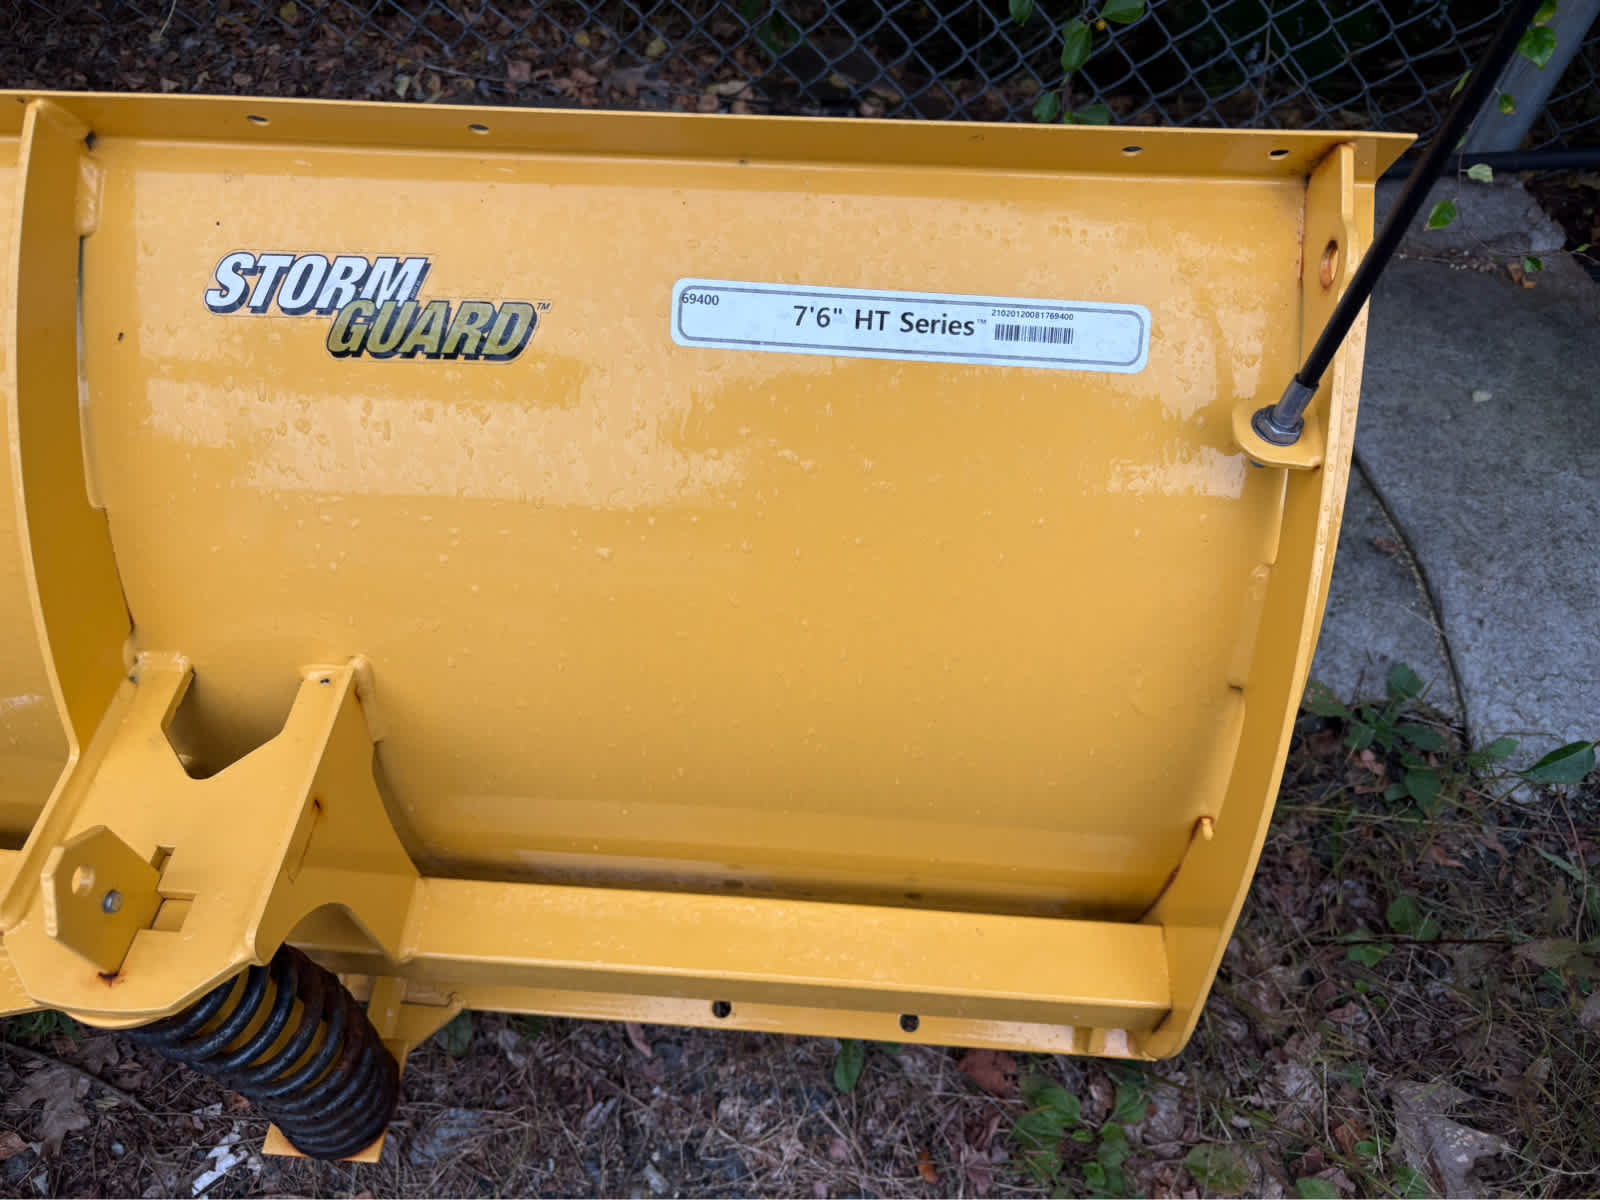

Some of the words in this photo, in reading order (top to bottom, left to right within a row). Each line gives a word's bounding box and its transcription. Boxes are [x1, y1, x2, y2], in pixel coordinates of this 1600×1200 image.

[204, 251, 431, 315] STORM
[680, 293, 720, 306] 69400
[793, 304, 843, 328] 7'6"
[855, 309, 891, 331] HT
[991, 304, 1075, 321] 21020120081769400
